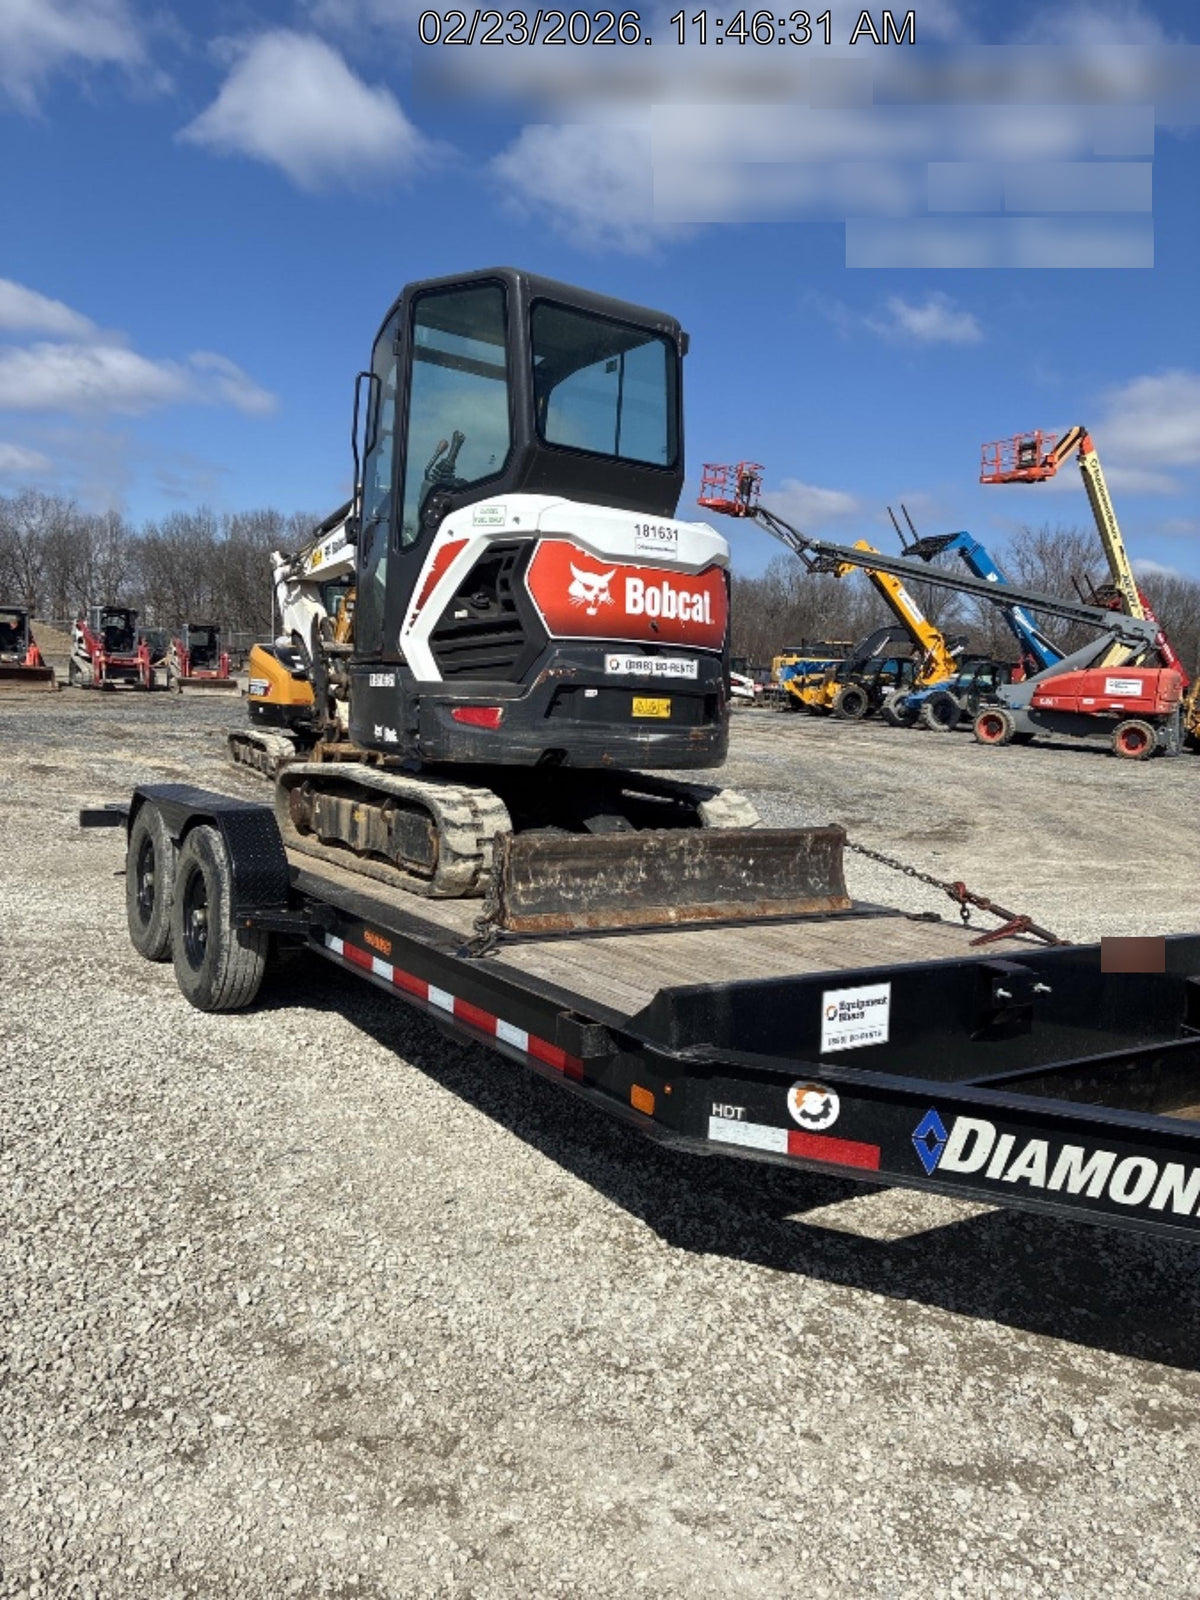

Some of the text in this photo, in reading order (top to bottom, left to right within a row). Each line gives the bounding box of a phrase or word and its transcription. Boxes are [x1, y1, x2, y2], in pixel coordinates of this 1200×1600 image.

[634, 523, 678, 541] 181631
[625, 576, 710, 625] Bobcat
[712, 1101, 745, 1120] HDT
[937, 1116, 1200, 1218] DIAMON
